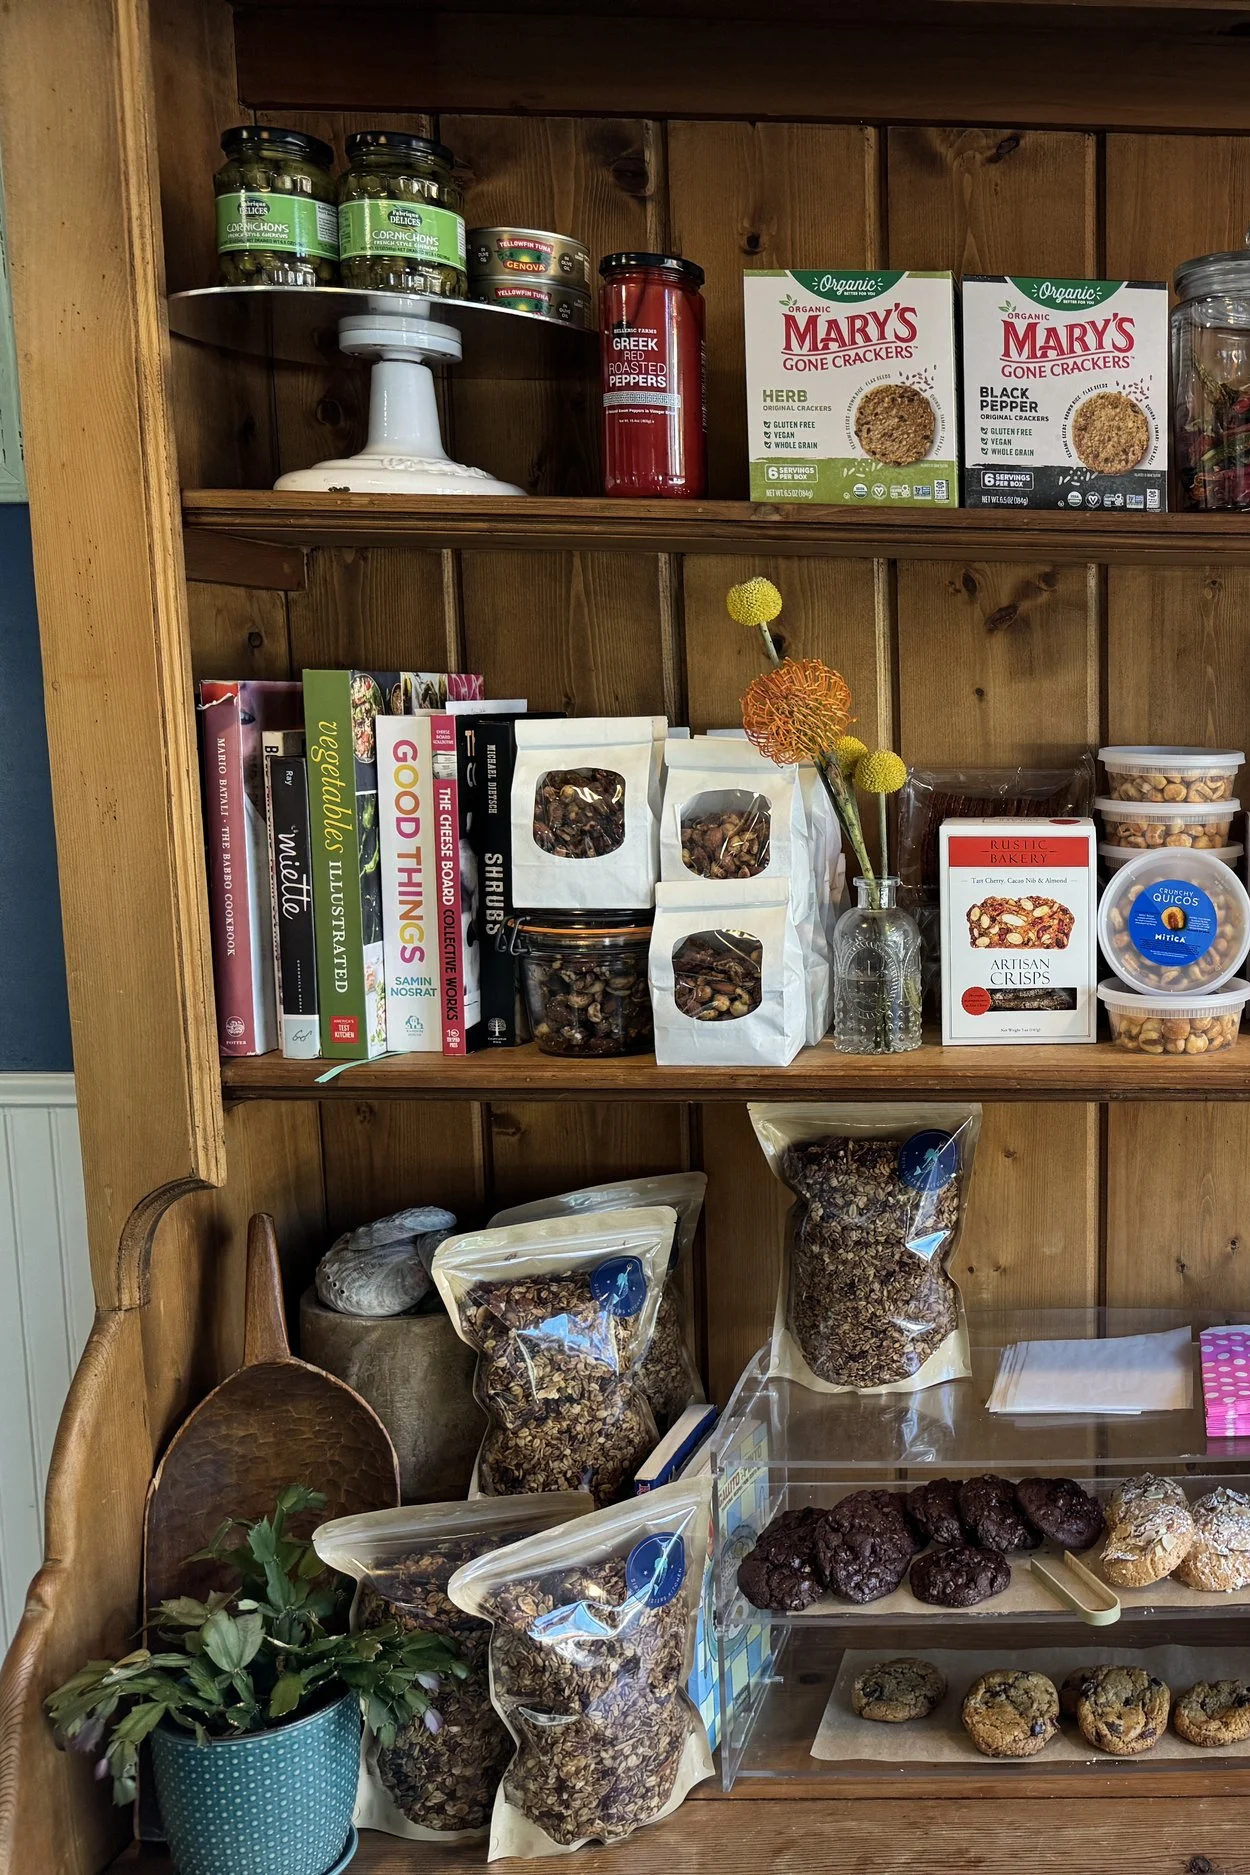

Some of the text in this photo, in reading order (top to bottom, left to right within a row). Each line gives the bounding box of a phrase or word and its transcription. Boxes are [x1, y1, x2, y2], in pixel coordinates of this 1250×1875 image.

[227, 222, 289, 233] CORNICHONS
[372, 230, 439, 246] CORNICHONS
[535, 243, 551, 253] TUNA
[507, 261, 546, 271] GENOVA
[819, 274, 877, 296] Organic
[532, 293, 549, 301] TUNA
[1039, 282, 1096, 303] Organic
[1007, 313, 1050, 321] ORGANIC
[782, 303, 918, 353] MARY'S
[1001, 313, 1135, 360] MARY'S
[613, 337, 658, 351] GREEK
[624, 351, 644, 360] RED
[783, 346, 913, 372] GONE CRACKERS
[609, 361, 666, 375] ROASTED
[1001, 356, 1130, 379] GONE CRACKERS
[610, 375, 666, 387] PEPPERS
[763, 389, 808, 403] HERB
[980, 387, 1029, 399] BLACK
[980, 400, 1038, 413] PEPPER
[773, 421, 798, 429] GLUTEN
[990, 428, 1032, 436] GLUTEN FREE
[990, 438, 1012, 446] VEGAN
[1014, 449, 1034, 457] GRAIN
[768, 466, 779, 480] 6
[285, 770, 293, 786] Ray
[487, 744, 498, 814] MICHAEL DIETSCH
[216, 738, 236, 956] MARIO BATALI THE BABBO COOKBOOK
[392, 739, 426, 964] GOOD THINGS
[990, 840, 1048, 850] RUSTIC
[311, 720, 353, 994] vegetables ILLUSTRATED
[990, 854, 1048, 864] BAKERY
[484, 853, 505, 936] SHRUBS
[1159, 887, 1194, 897] CRUNCHY
[438, 788, 458, 1021] THE CHEESE BOARD COLLECTIVE WORKS
[1153, 893, 1199, 906] QUICOS
[990, 958, 1050, 970] ARTISAN
[394, 976, 432, 986] SAMIN
[990, 971, 1050, 985] CRISPS
[390, 987, 438, 997] NOSRAT
